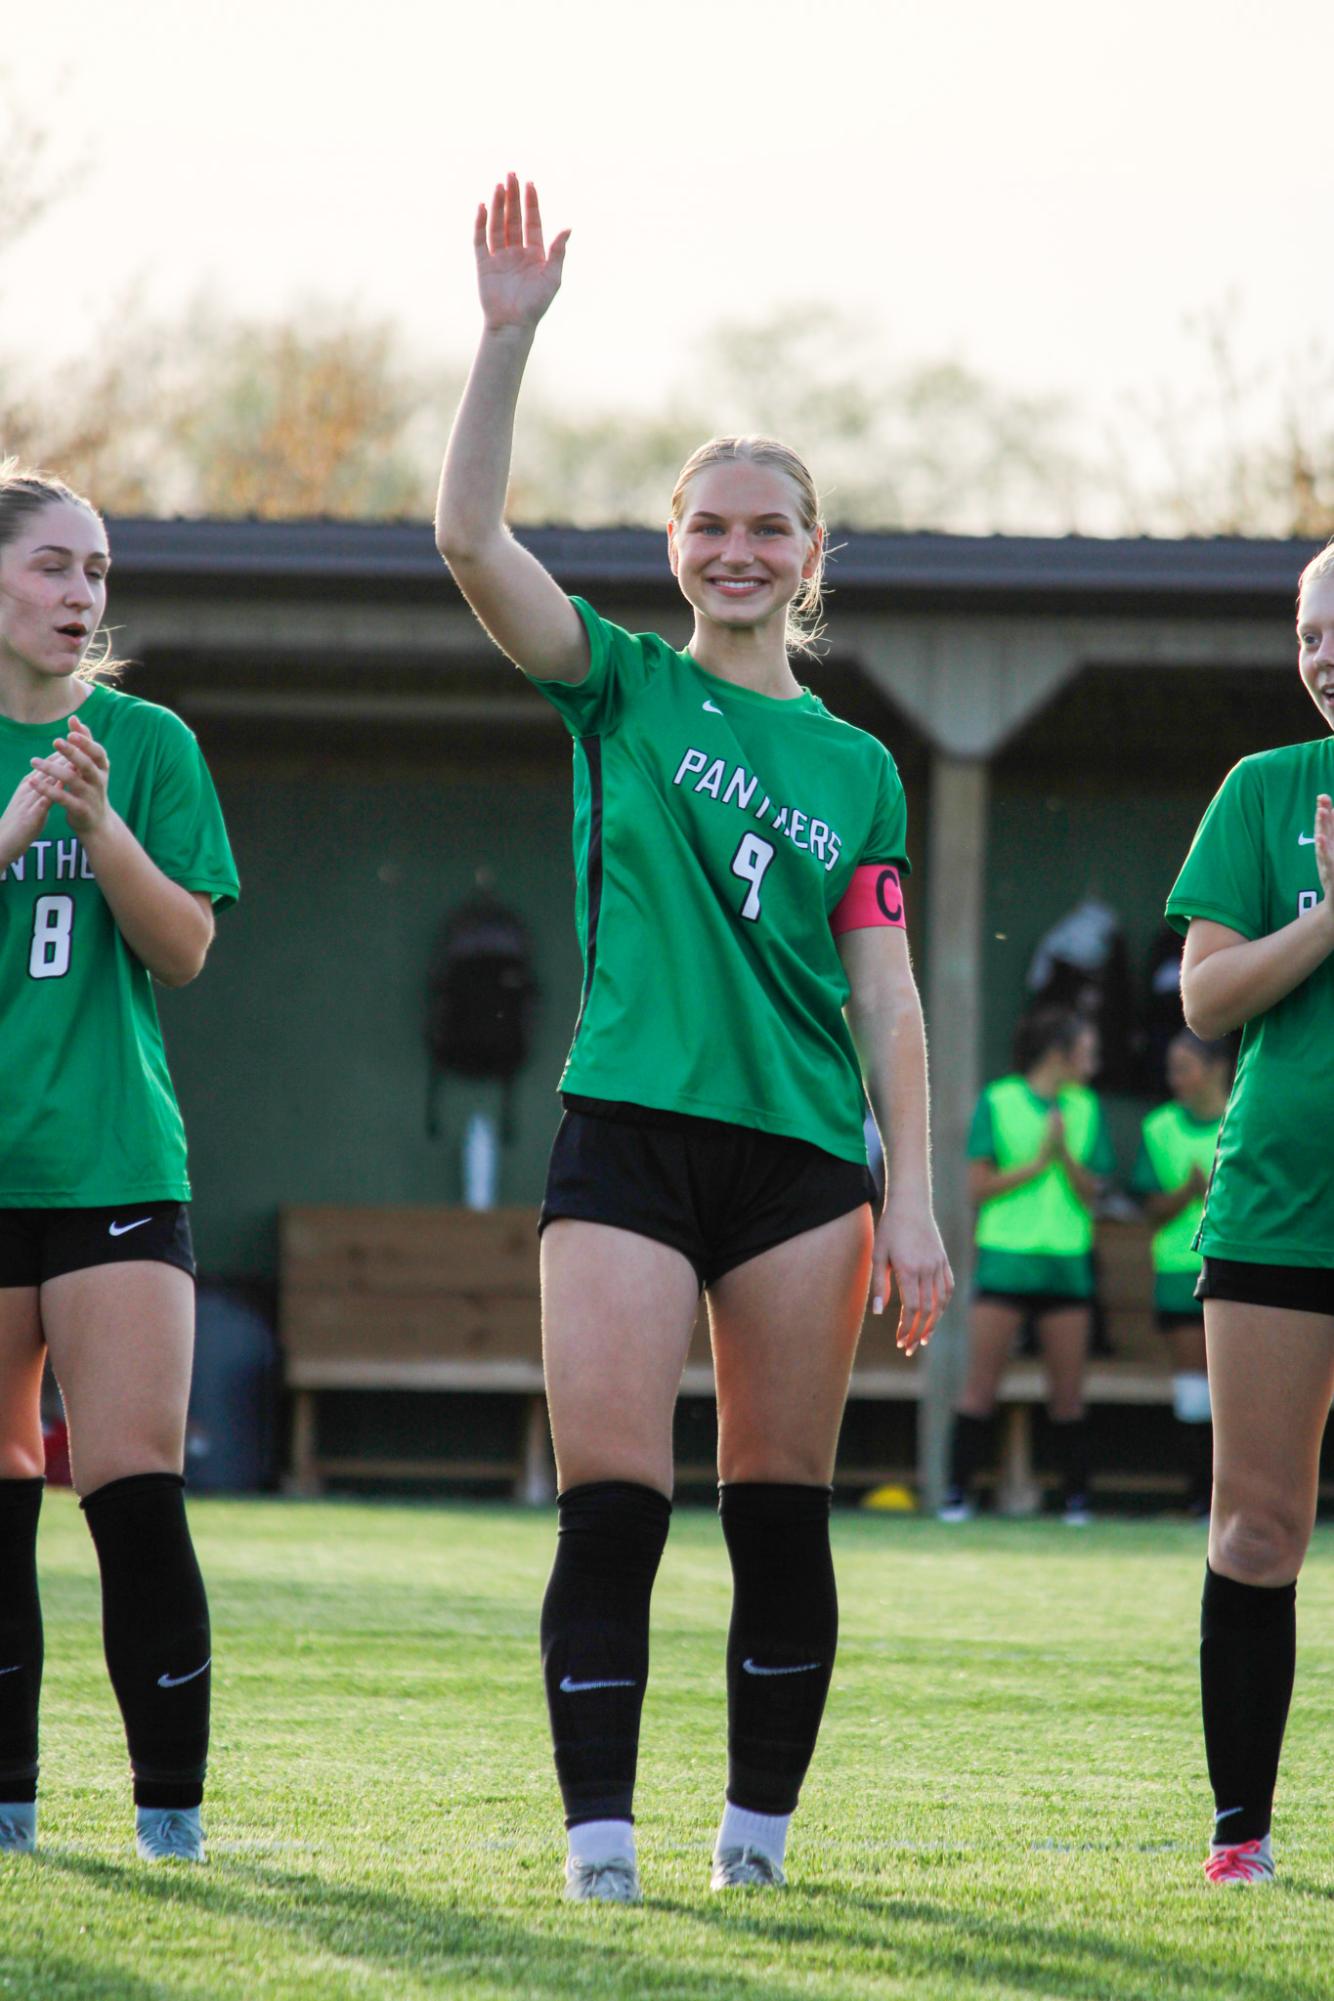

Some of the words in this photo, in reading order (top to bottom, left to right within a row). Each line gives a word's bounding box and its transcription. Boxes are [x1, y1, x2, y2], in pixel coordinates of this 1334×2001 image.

[730, 830, 777, 923] 9
[875, 869, 903, 922] C
[28, 892, 75, 981] 8
